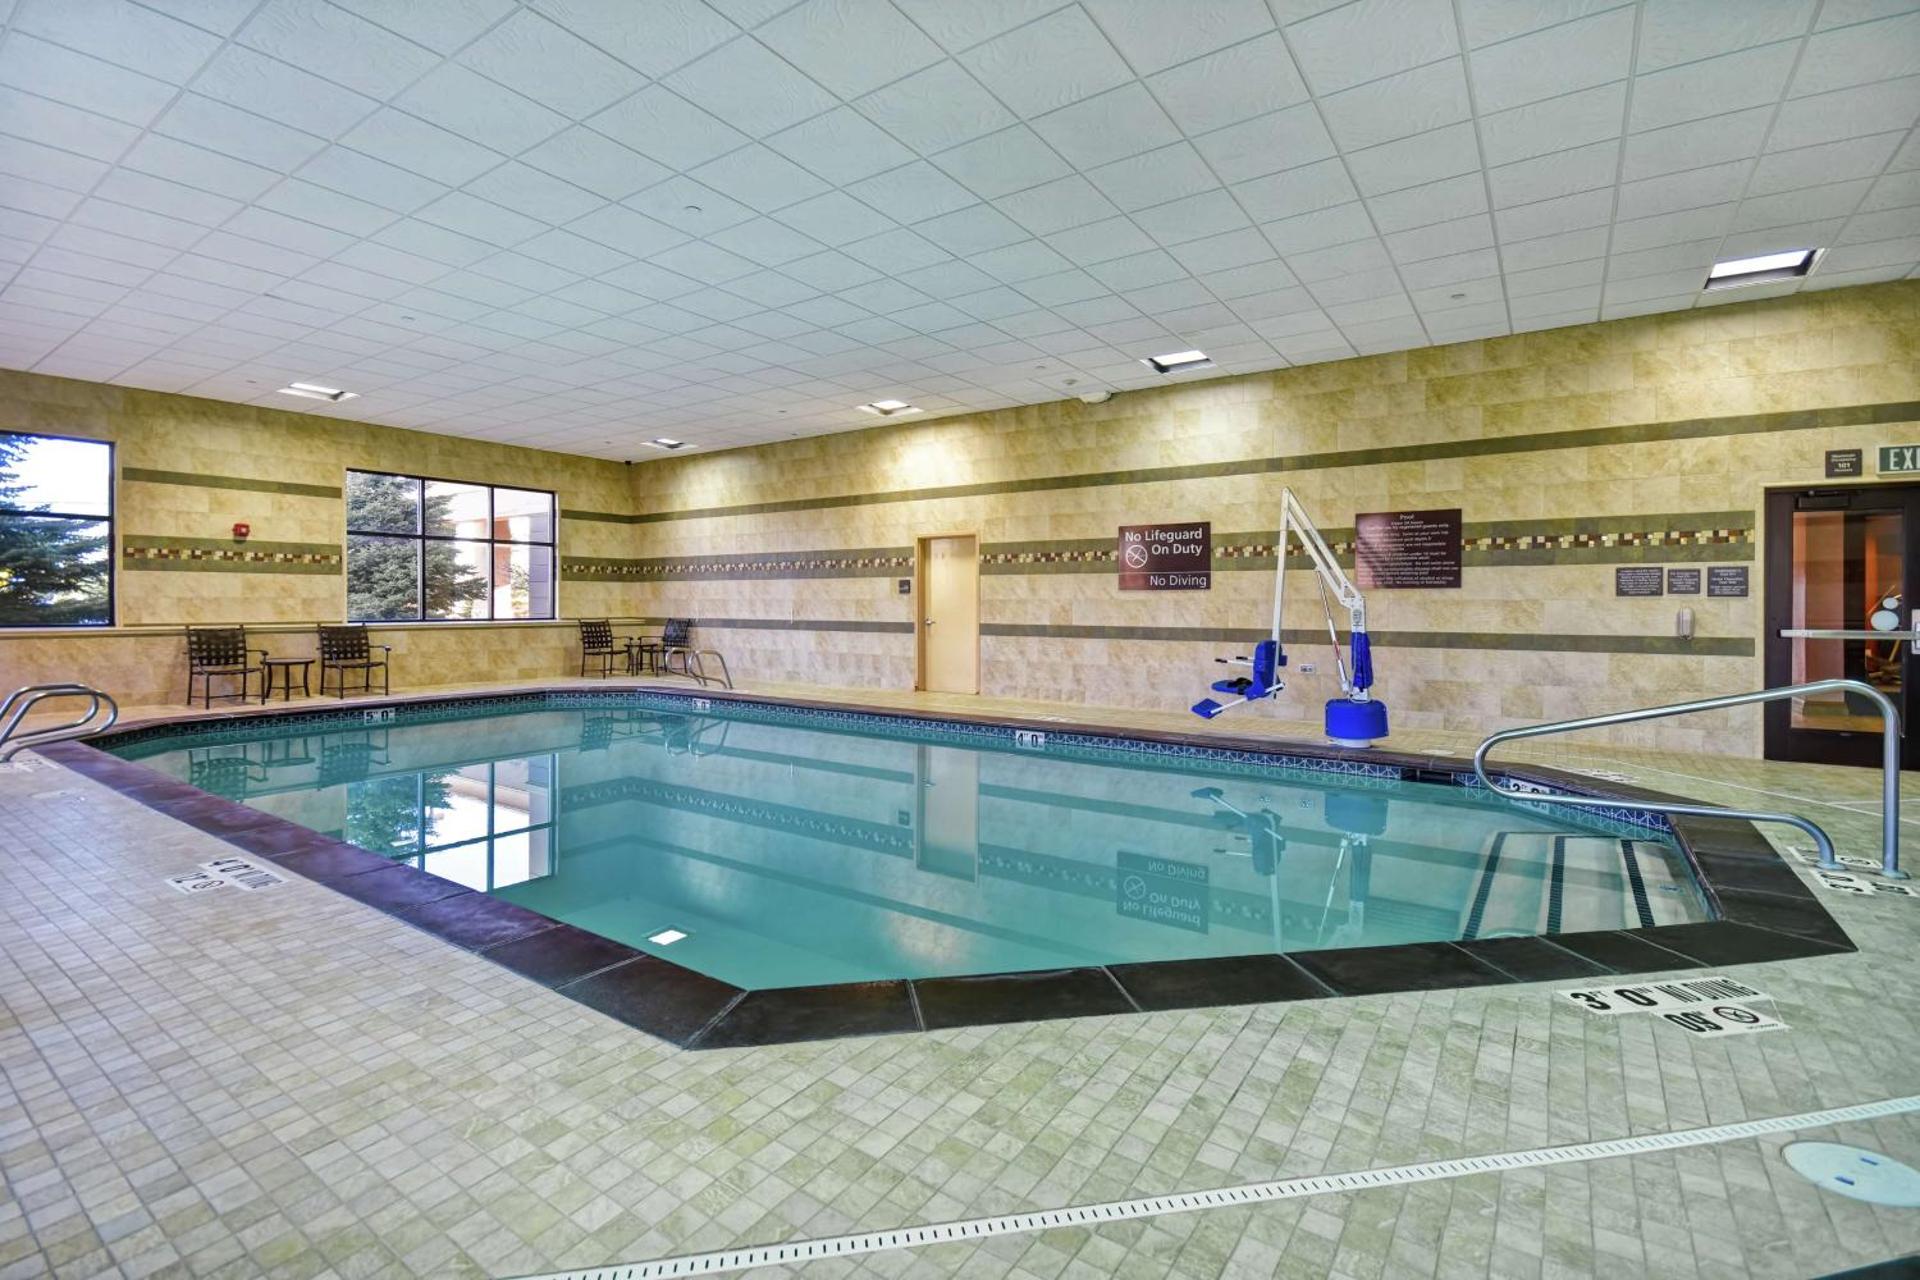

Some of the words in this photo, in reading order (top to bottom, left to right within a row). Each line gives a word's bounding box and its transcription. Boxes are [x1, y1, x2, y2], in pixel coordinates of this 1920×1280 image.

[1125, 532, 1141, 542] No
[1145, 528, 1203, 544] Lifeguard
[1151, 543, 1169, 555] On
[1173, 543, 1203, 557] Duty
[1150, 576, 1166, 586] No
[1169, 575, 1207, 588] Diving
